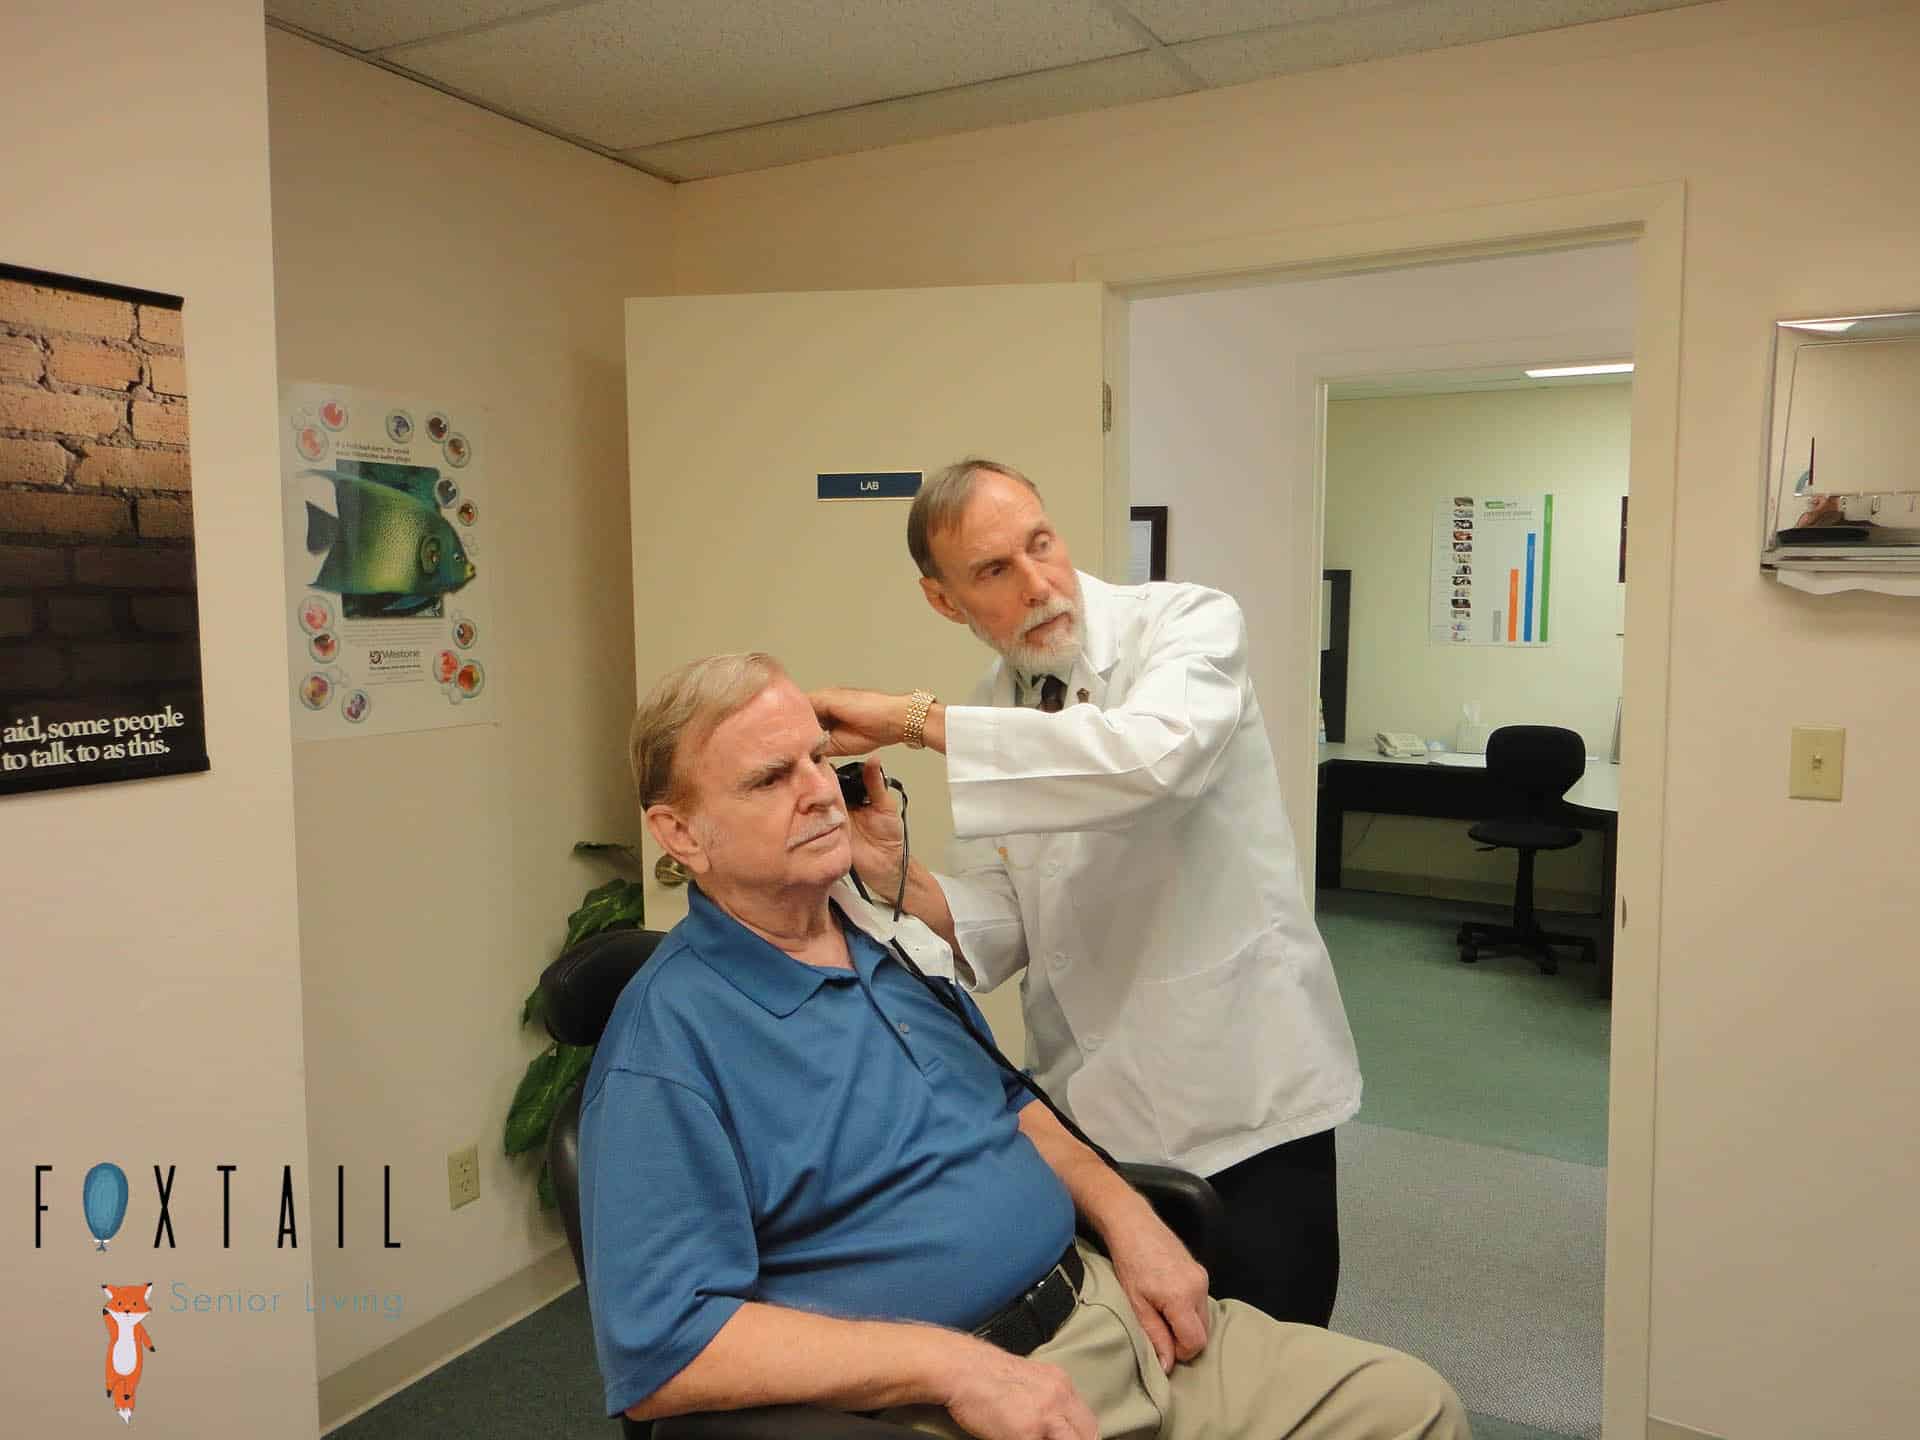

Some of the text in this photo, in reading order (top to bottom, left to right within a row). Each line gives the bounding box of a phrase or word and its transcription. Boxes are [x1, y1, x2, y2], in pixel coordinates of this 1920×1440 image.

[860, 480, 880, 491] LAB
[3, 704, 185, 744] aid, some people
[1, 733, 171, 771] to talk to as this.
